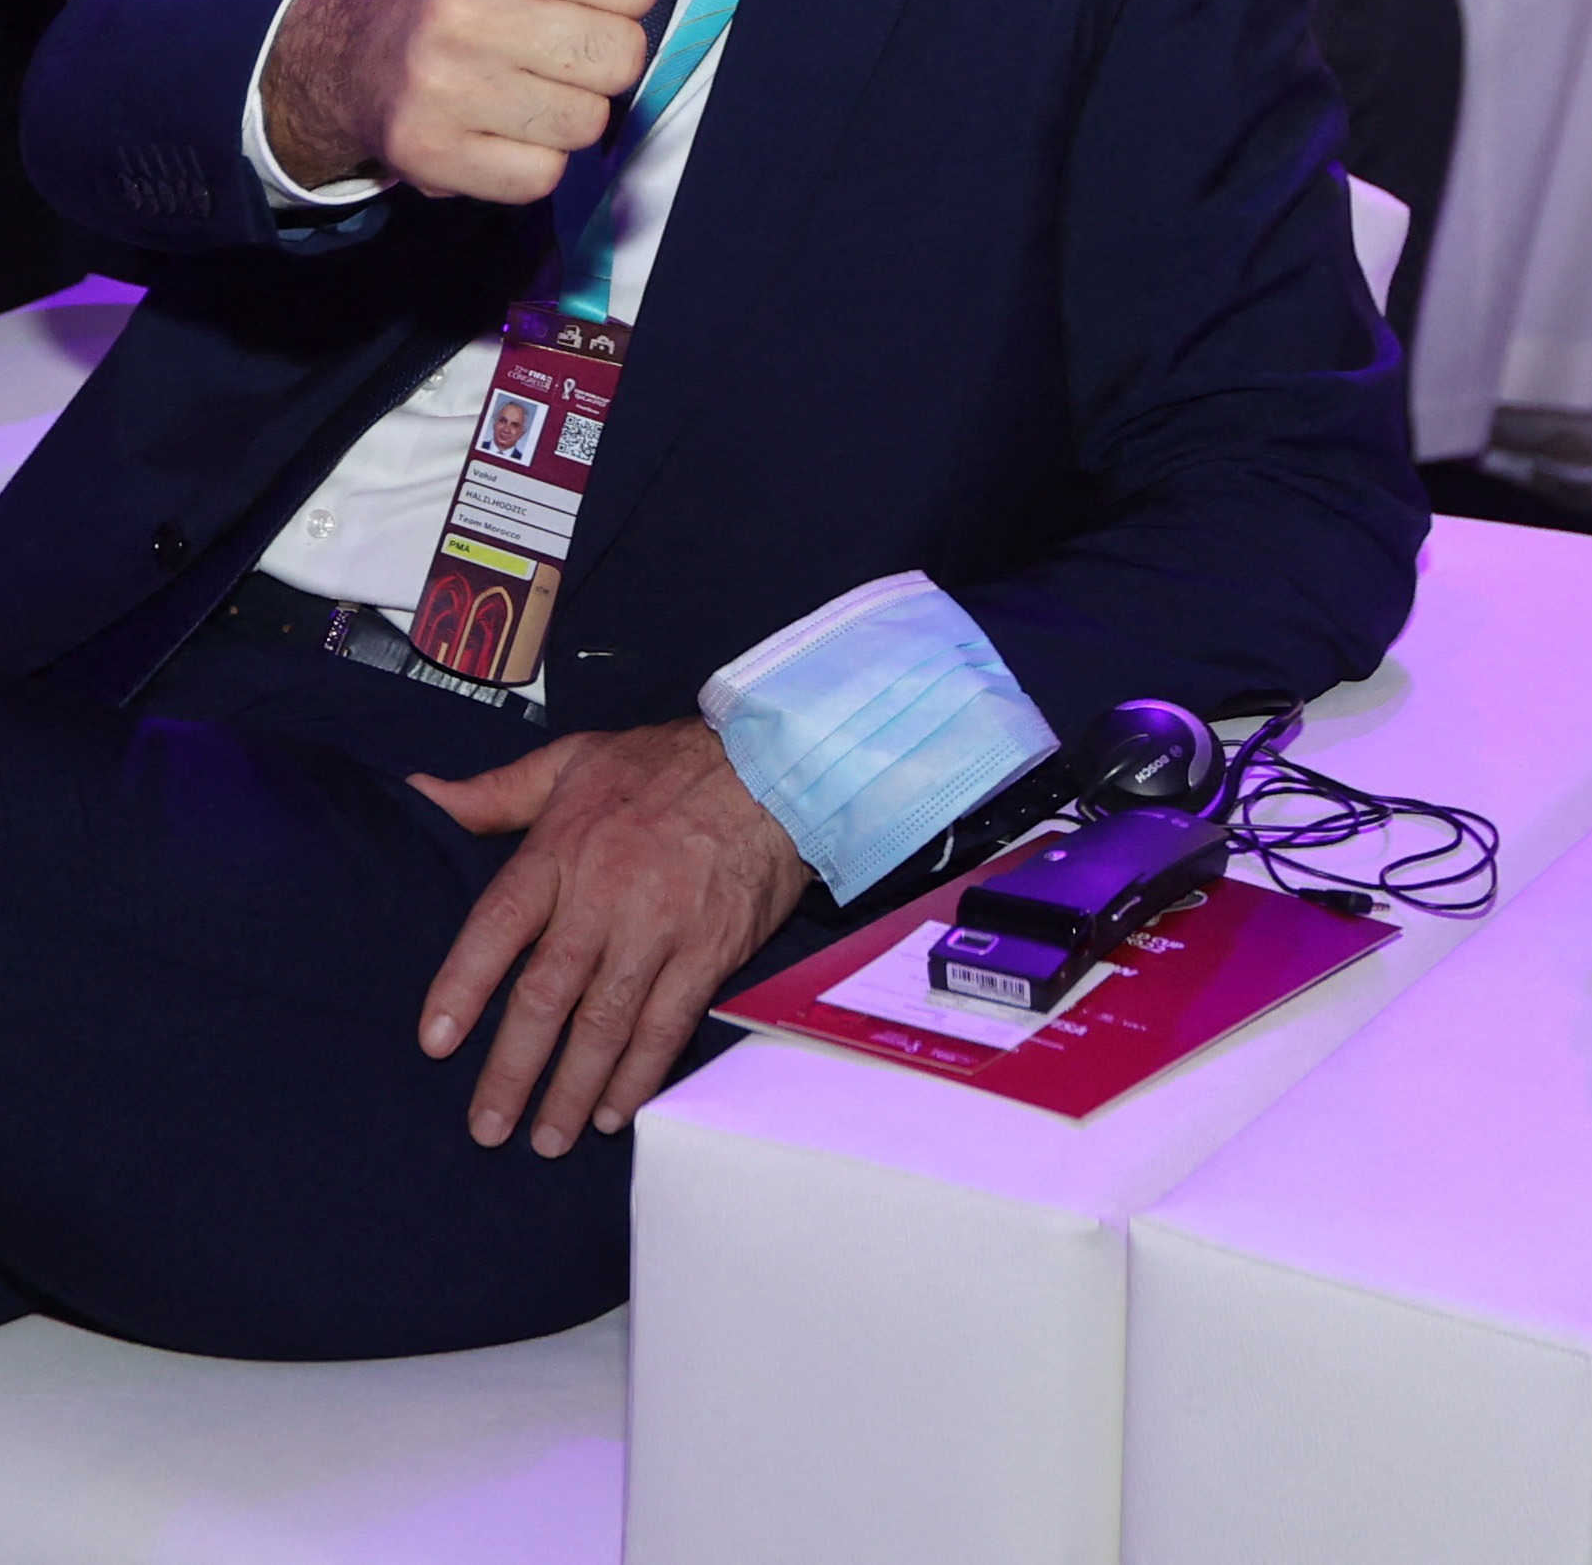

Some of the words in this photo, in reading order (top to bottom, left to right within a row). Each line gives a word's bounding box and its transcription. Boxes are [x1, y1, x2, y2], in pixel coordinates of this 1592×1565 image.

[473, 468, 497, 482] Vahid
[465, 490, 527, 516] HALILHODZIC
[458, 514, 482, 528] Team
[483, 523, 521, 540] Morocco
[448, 540, 470, 553] PMA
[1135, 754, 1170, 783] BOSCH
